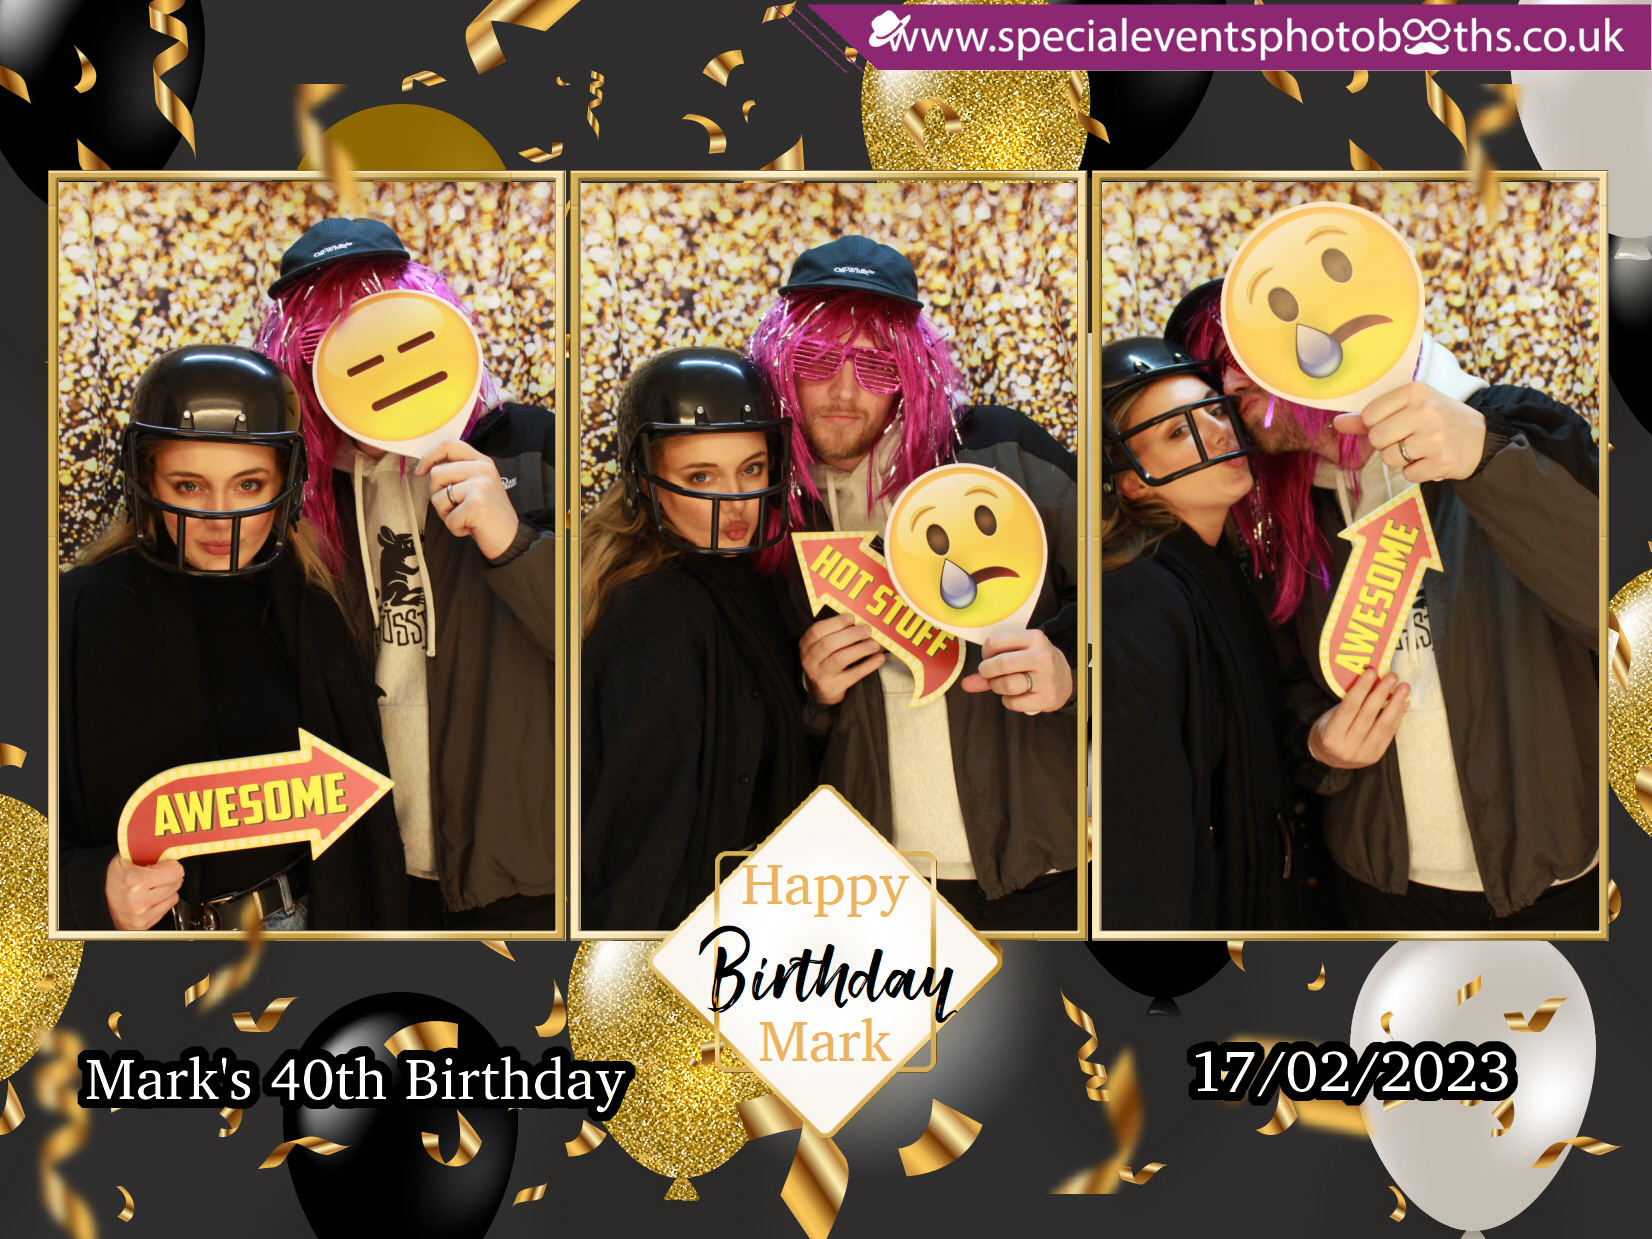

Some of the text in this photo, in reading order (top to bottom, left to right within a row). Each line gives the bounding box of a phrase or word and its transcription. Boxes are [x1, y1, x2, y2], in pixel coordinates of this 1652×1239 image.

[810, 544, 957, 658] HOT STUFF
[1334, 518, 1421, 676] AWESOME
[155, 772, 348, 837] AWESOME
